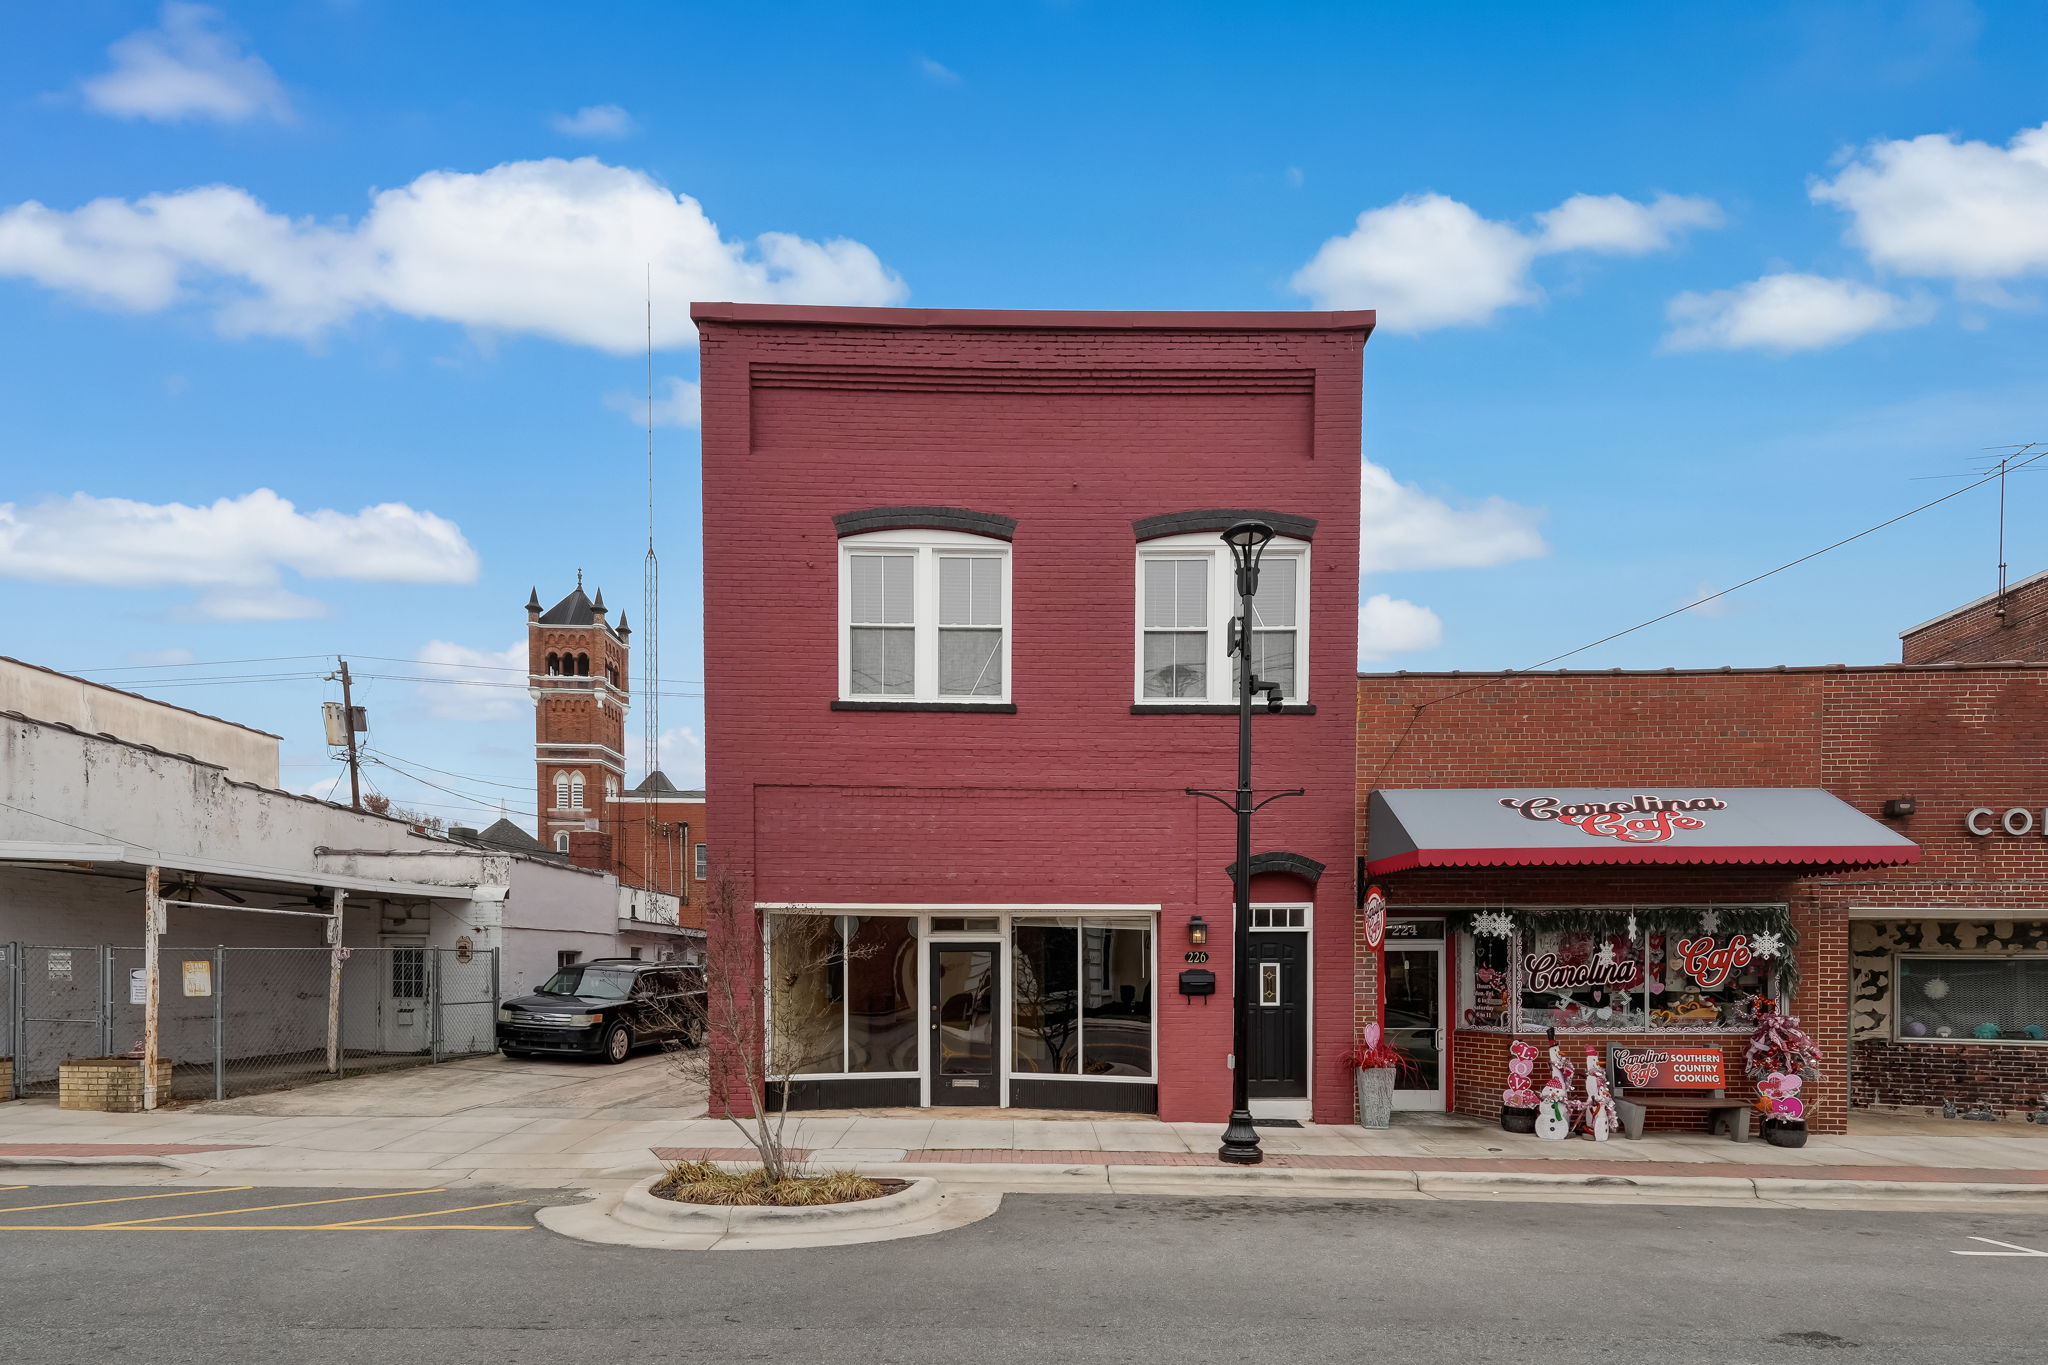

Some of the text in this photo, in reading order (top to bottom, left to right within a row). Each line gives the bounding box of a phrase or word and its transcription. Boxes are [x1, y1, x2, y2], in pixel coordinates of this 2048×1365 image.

[1499, 795, 1727, 821] Carolina
[1557, 810, 1706, 843] Cafe
[1392, 924, 1418, 936] 224
[1187, 951, 1207, 964] 226
[1677, 935, 1752, 988] Cafe
[1524, 953, 1637, 993] Carolina
[1614, 1049, 1669, 1068] Carolina
[1670, 1054, 1720, 1063] SOUTHERN
[1624, 1063, 1658, 1087] Cafe
[1673, 1064, 1718, 1073] COUNTRY
[1673, 1074, 1720, 1083] COOKING
